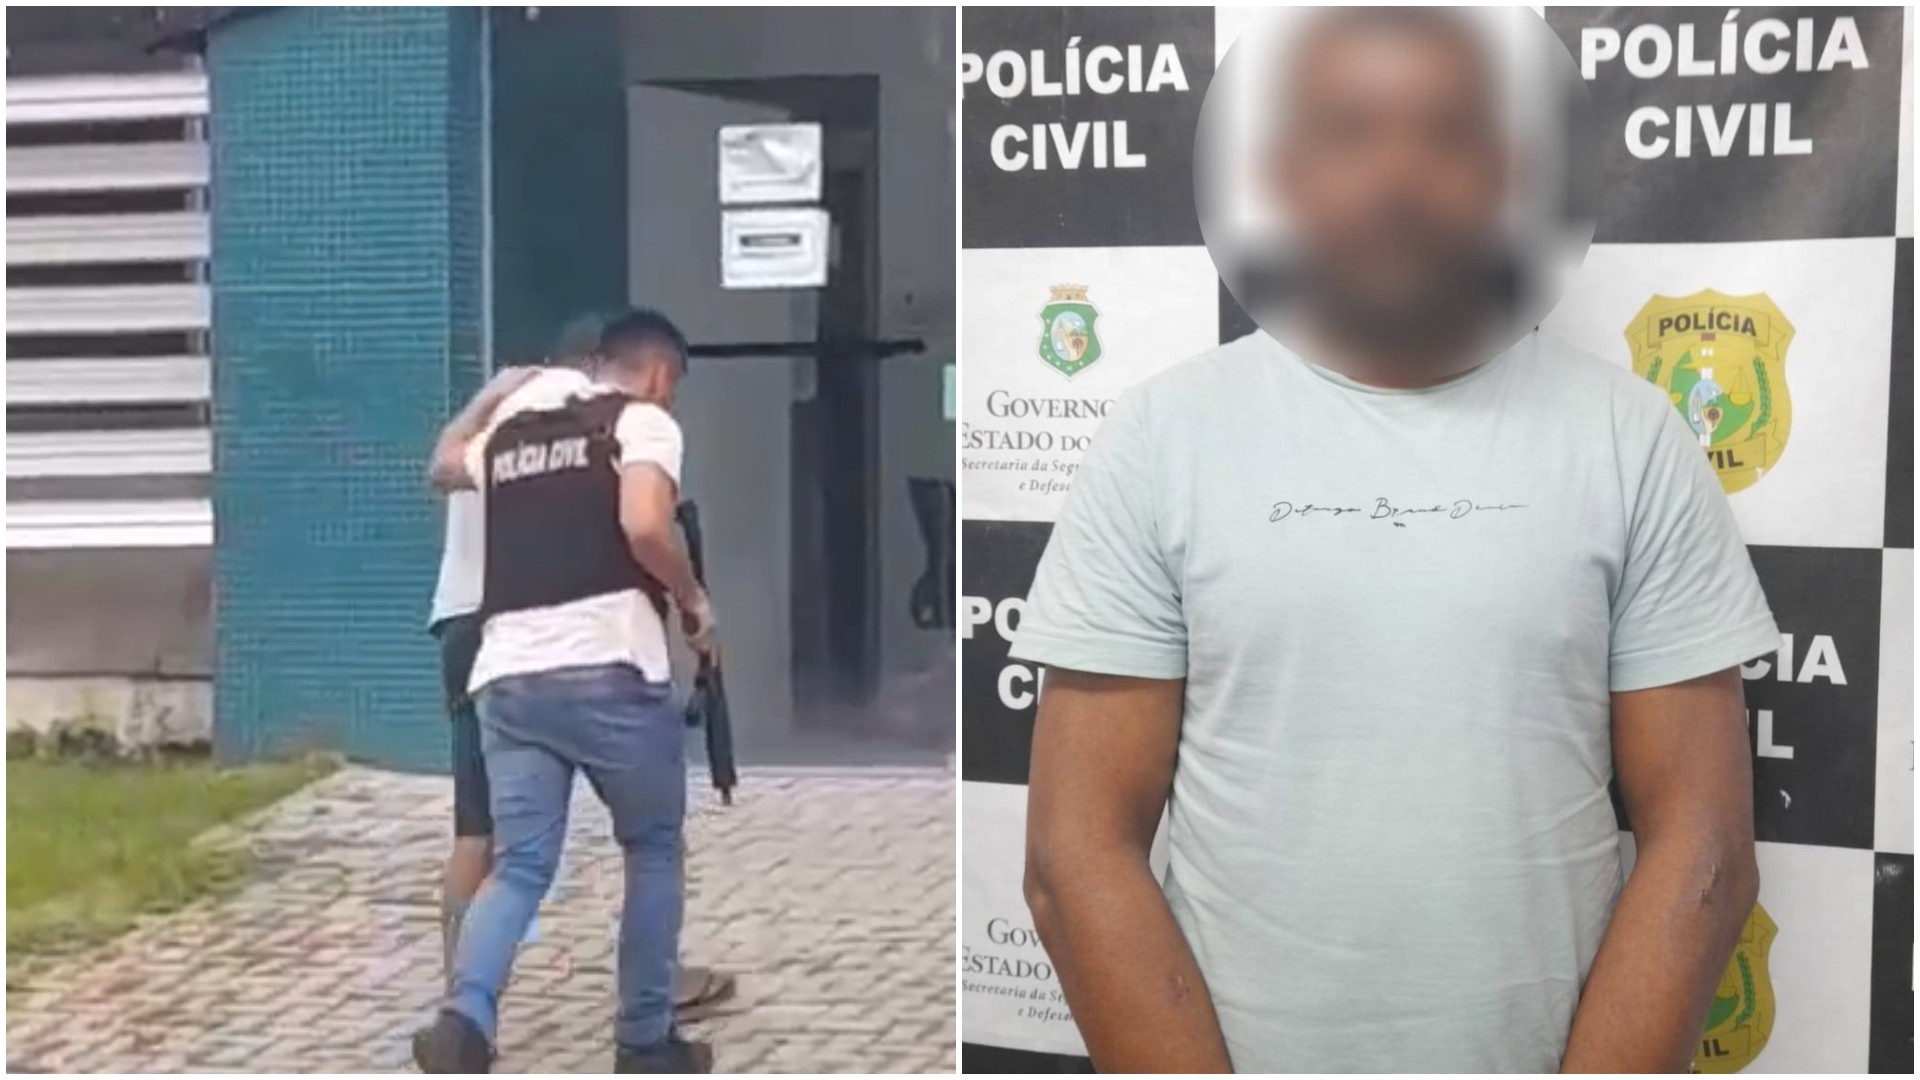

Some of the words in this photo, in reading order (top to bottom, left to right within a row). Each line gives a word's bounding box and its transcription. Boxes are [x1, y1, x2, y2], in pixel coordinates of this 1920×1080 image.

[962, 36, 1190, 99] POLÍCIA
[1580, 8, 1870, 80] POLÍCIA
[990, 120, 1147, 172] CIVIL
[1624, 102, 1813, 159] CIVIL
[1659, 306, 1757, 337] POLÍCIA
